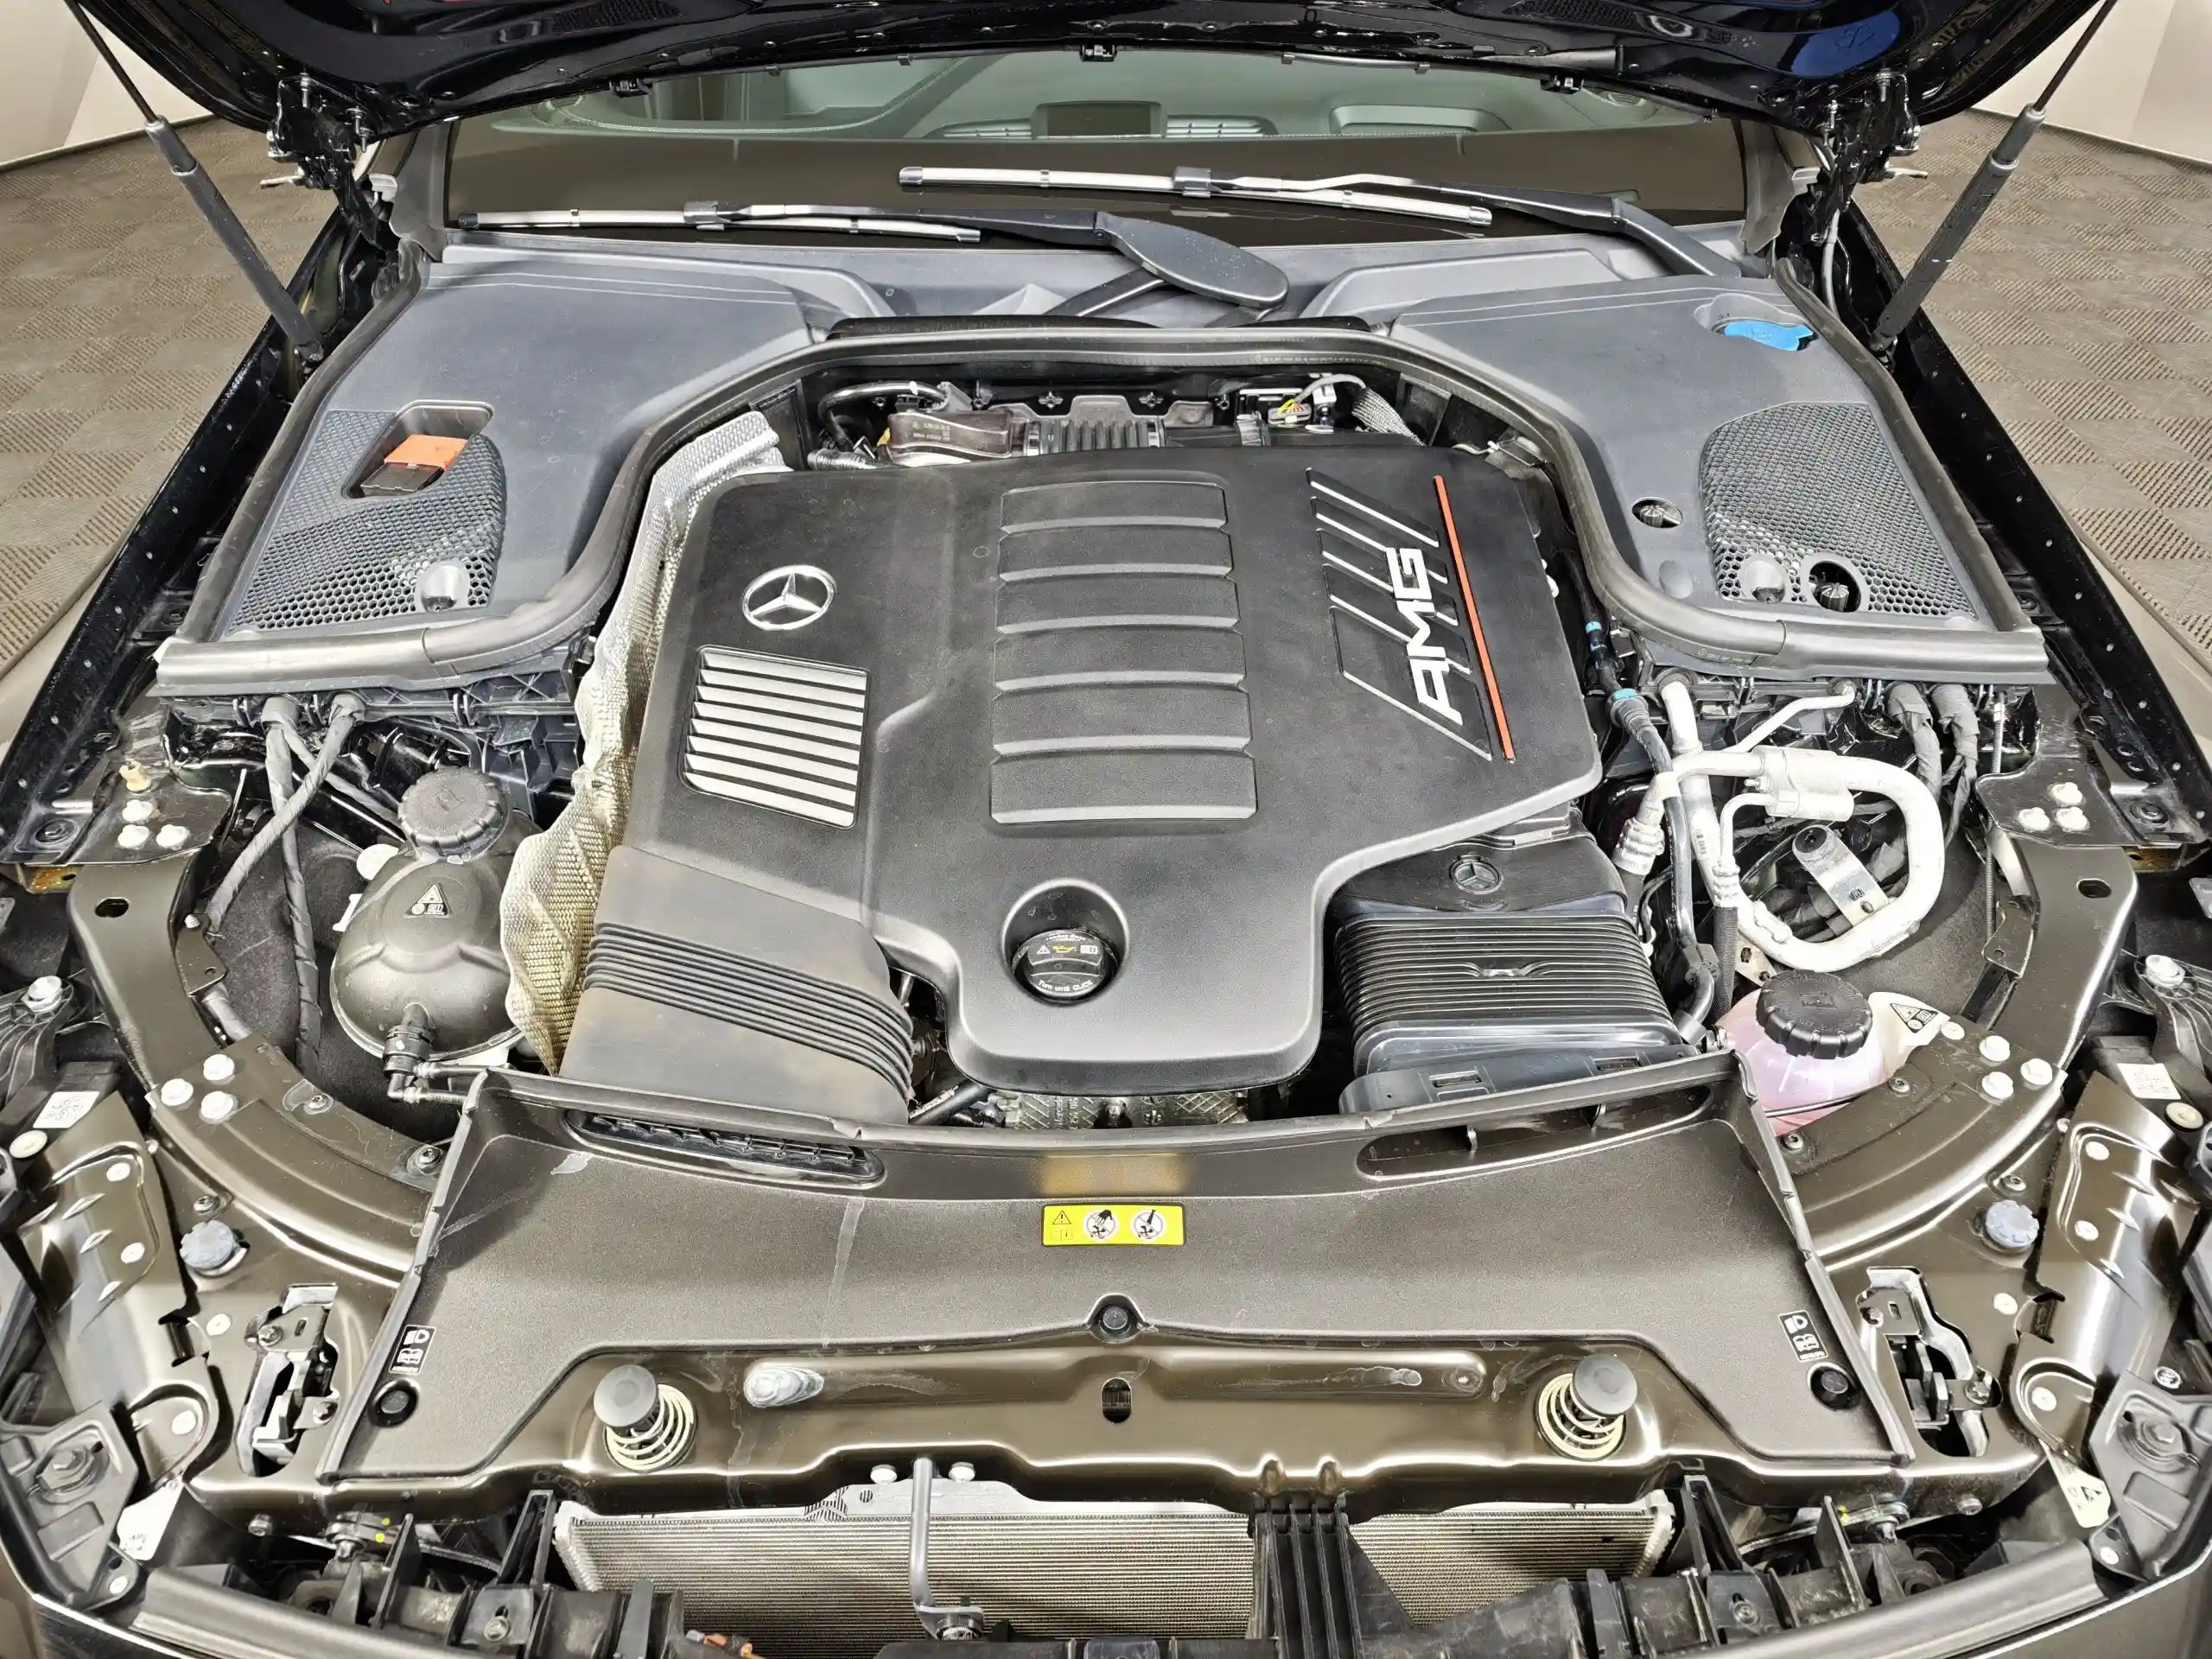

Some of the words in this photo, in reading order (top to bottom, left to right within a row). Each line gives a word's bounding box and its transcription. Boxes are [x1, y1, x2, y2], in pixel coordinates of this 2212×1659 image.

[1385, 547, 1463, 725] AMG
[1038, 979, 1052, 990] Turn
[1072, 979, 1094, 991] CLICK
